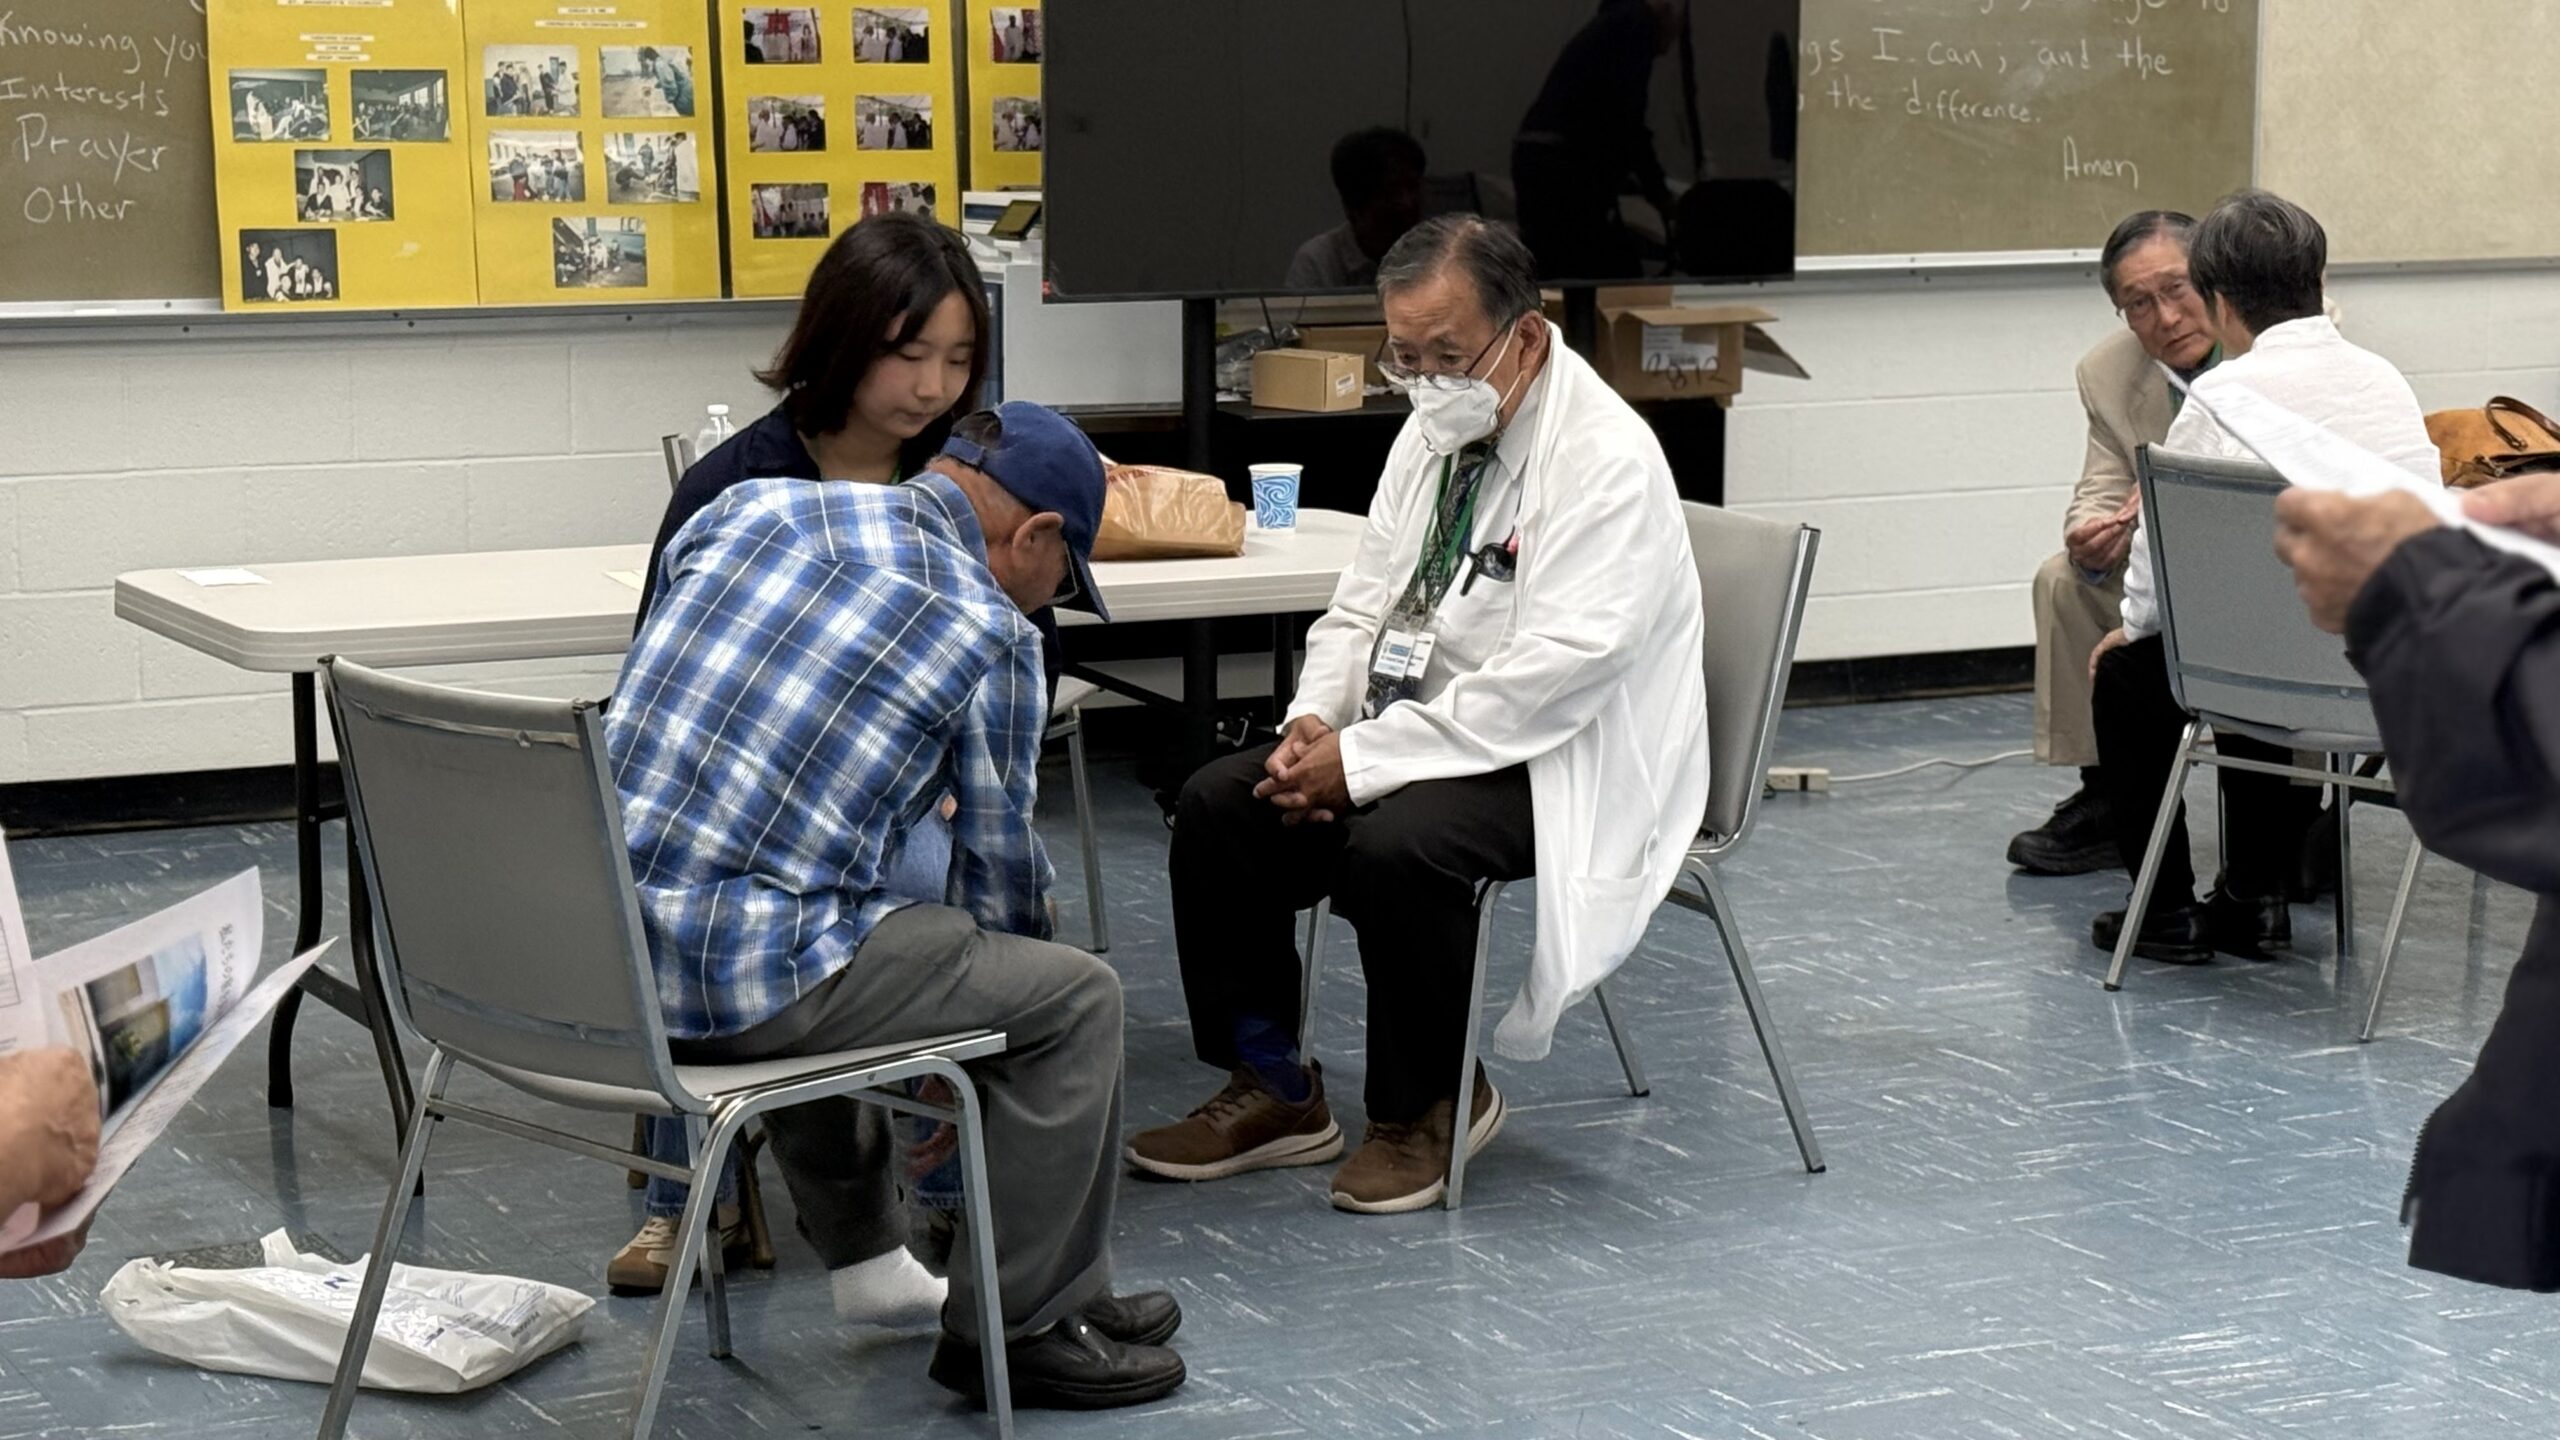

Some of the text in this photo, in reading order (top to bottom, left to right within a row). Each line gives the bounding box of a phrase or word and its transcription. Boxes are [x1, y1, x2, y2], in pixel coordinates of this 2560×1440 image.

[0, 11, 141, 74] Knowing
[1798, 38, 1844, 76] gs
[1872, 27, 1902, 62] I
[2037, 38, 2090, 70] and
[2117, 36, 2173, 79] the
[0, 73, 168, 117] Interests
[1826, 75, 2042, 123] the difference.
[17, 113, 166, 185] Prayer
[2063, 136, 2138, 189] Amen
[25, 182, 135, 222] Other
